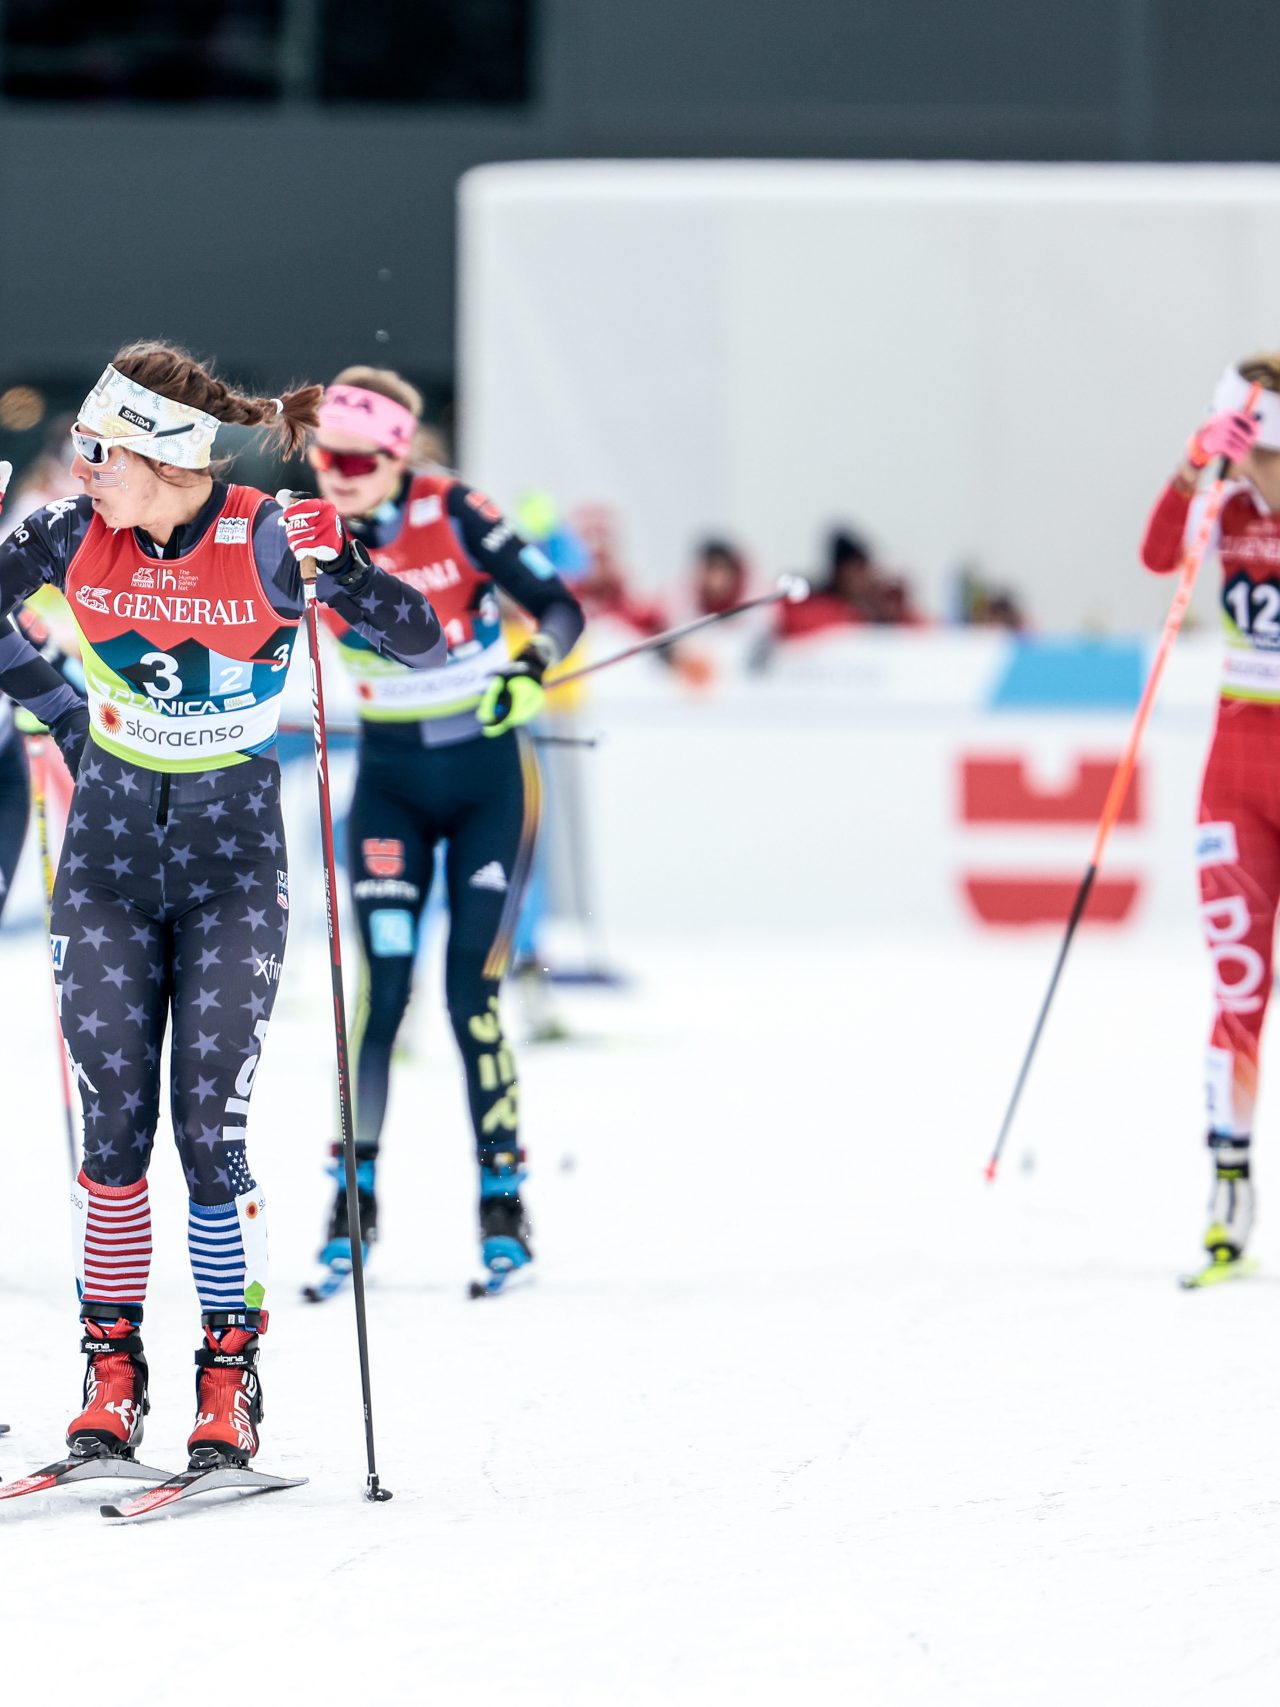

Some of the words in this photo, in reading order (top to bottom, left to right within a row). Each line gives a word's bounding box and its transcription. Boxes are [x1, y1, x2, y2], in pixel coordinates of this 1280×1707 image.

[122, 409, 151, 430] SKIDA
[113, 591, 257, 626] GENERALI
[1226, 580, 1280, 632] 12
[270, 643, 290, 672] 3
[139, 651, 183, 699] 3
[218, 666, 244, 693] 2
[113, 689, 222, 716] PLANICA
[125, 719, 244, 747] storaenso
[214, 1355, 244, 1364] alpina
